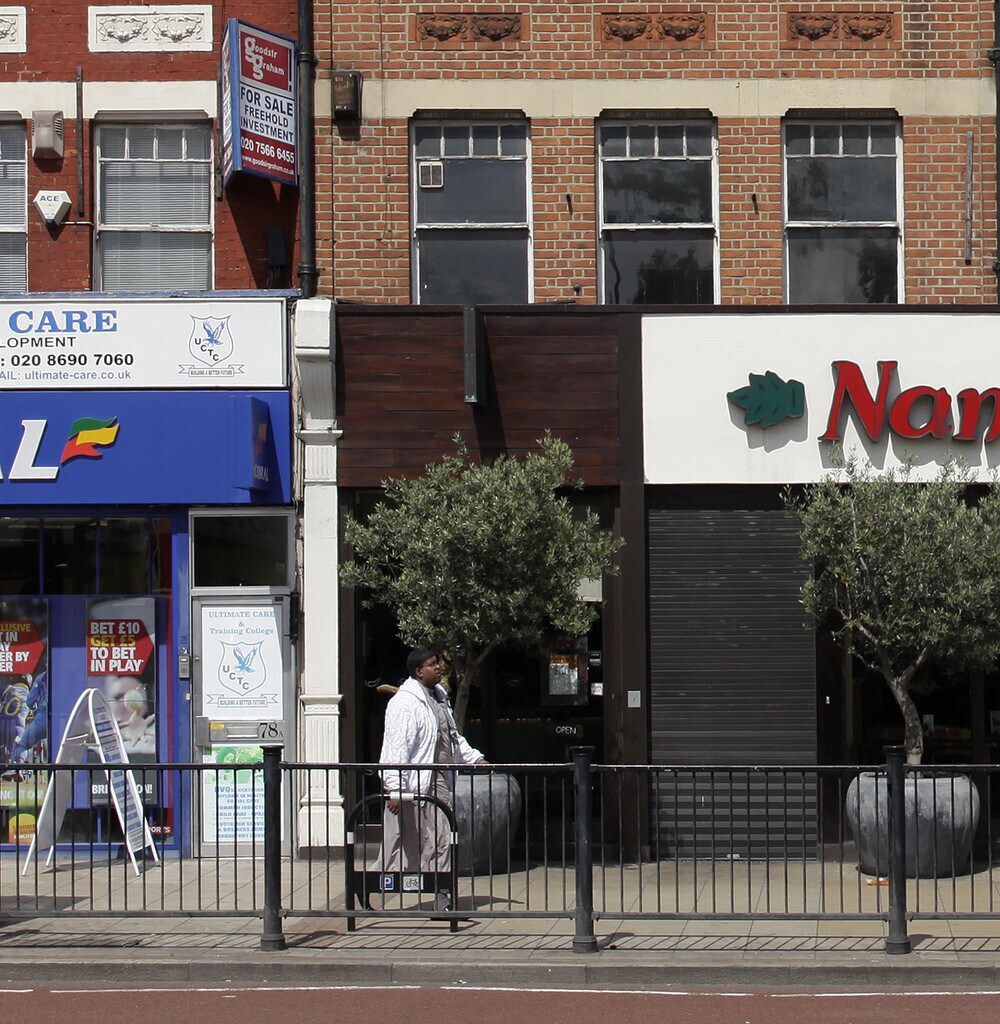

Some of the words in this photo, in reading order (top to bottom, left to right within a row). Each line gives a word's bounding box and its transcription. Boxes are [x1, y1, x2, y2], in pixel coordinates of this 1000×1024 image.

[241, 86, 261, 107] FOR
[264, 95, 293, 117] SALE
[245, 105, 289, 127] FREEHOLD
[241, 117, 294, 142] INVESTMENT
[241, 137, 254, 151] 020
[256, 141, 275, 158] 7566
[276, 148, 295, 164] 6455
[8, 310, 118, 334] CARE
[11, 355, 41, 367] 020
[47, 354, 88, 366] 8690
[93, 353, 134, 366] 7060
[25, 369, 132, 380] ultimate-care.co.uk
[91, 622, 115, 634] BET
[118, 622, 140, 634] £10
[246, 627, 275, 635] College
[6, 632, 18, 641] IN
[91, 635, 116, 647] GET
[120, 635, 136, 647] £5
[15, 652, 30, 661] BY
[90, 647, 109, 659] TO
[112, 647, 136, 659] BET
[91, 660, 106, 672] IN
[555, 726, 577, 734] OPEN
[384, 877, 392, 887] P
